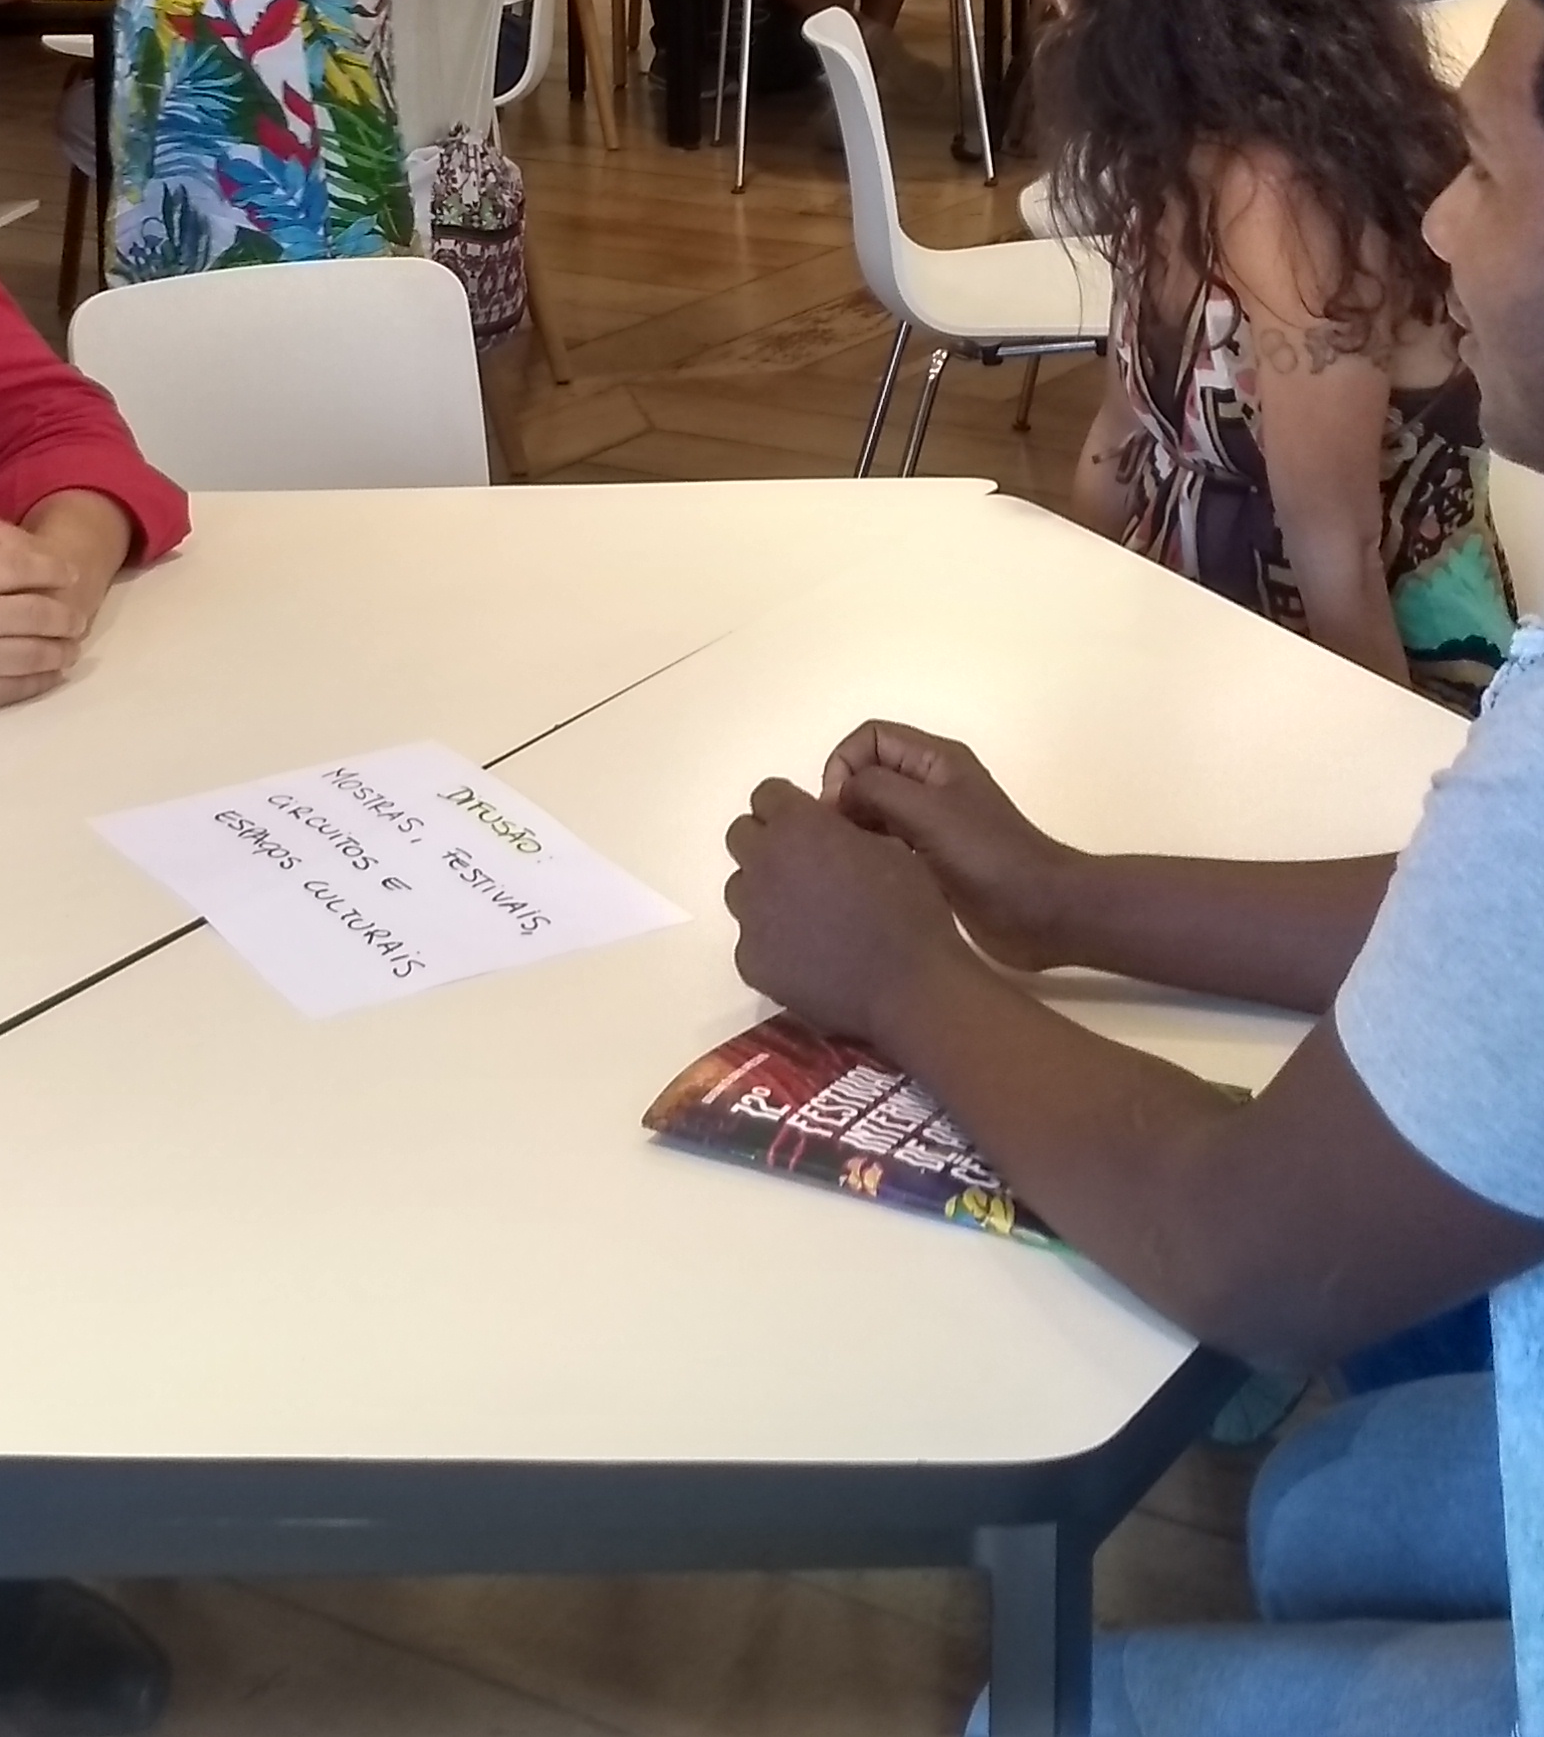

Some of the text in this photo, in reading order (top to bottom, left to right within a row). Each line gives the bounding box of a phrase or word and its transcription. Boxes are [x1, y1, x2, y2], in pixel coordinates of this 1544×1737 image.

[214, 810, 426, 979] ESPAÇOS CULTURAIS
[267, 793, 413, 891] CIRCUITOS E
[322, 766, 552, 936] MOSTRAS, FESTIVAIS,
[786, 1064, 906, 1138] FESTIVAL
